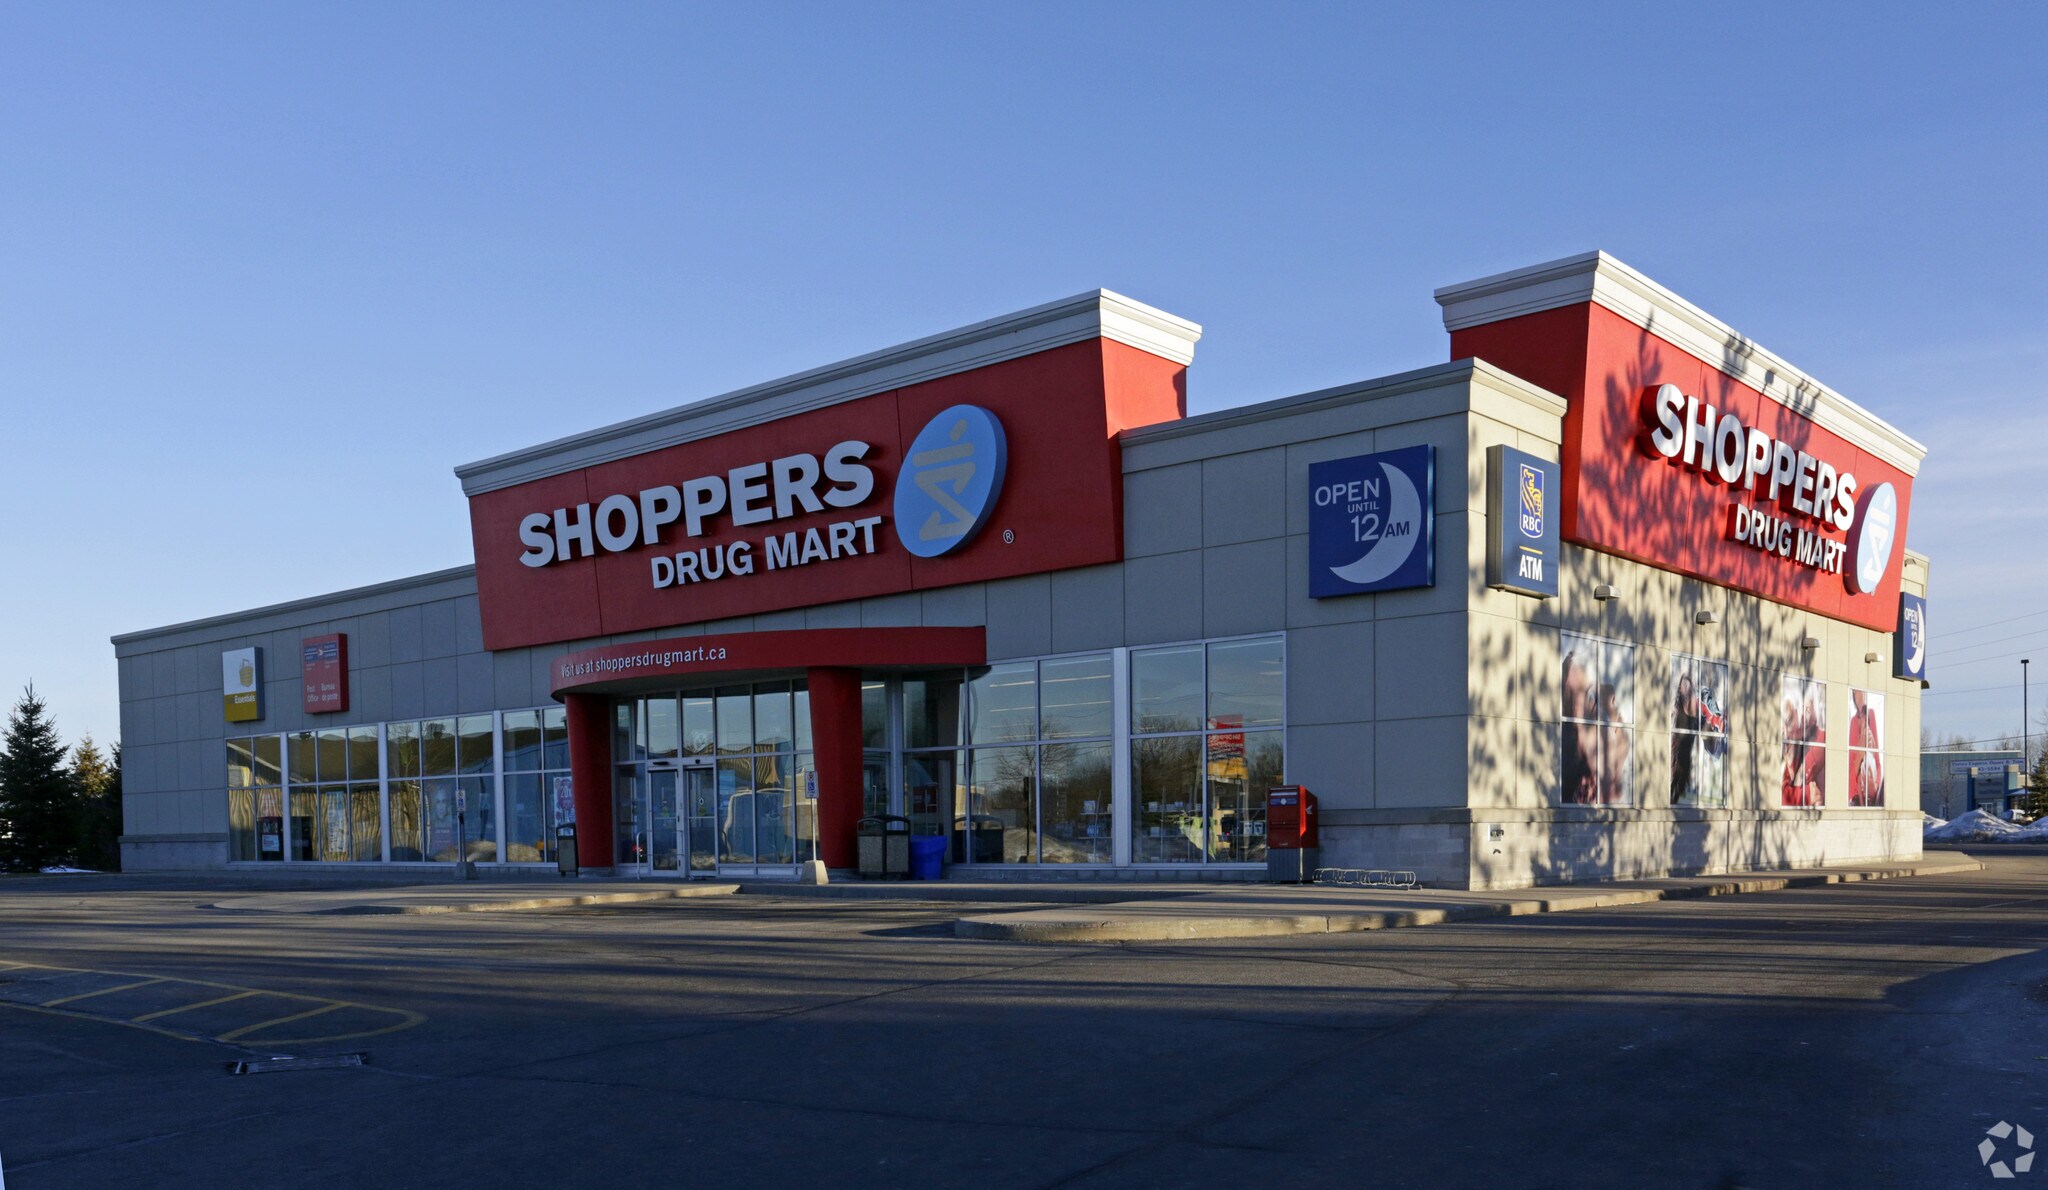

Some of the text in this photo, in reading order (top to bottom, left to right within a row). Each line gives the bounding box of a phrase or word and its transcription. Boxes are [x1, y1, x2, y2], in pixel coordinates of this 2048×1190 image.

[1651, 383, 1858, 532] SHOPPERS
[518, 440, 875, 569] SHOPPERS
[1314, 478, 1380, 507] OPEN
[1347, 501, 1380, 514] UNTIL
[1350, 513, 1410, 542] 12 AM
[1522, 514, 1541, 534] RBC
[650, 516, 882, 589] DRUG MART
[1735, 503, 1848, 575] DRUG MART
[1518, 554, 1543, 582] ATM
[1905, 607, 1918, 623] OPEN
[561, 646, 727, 678] Visit us at shoppersdrugmart.ca
[234, 694, 256, 704] Essentials
[307, 694, 319, 703] Office
